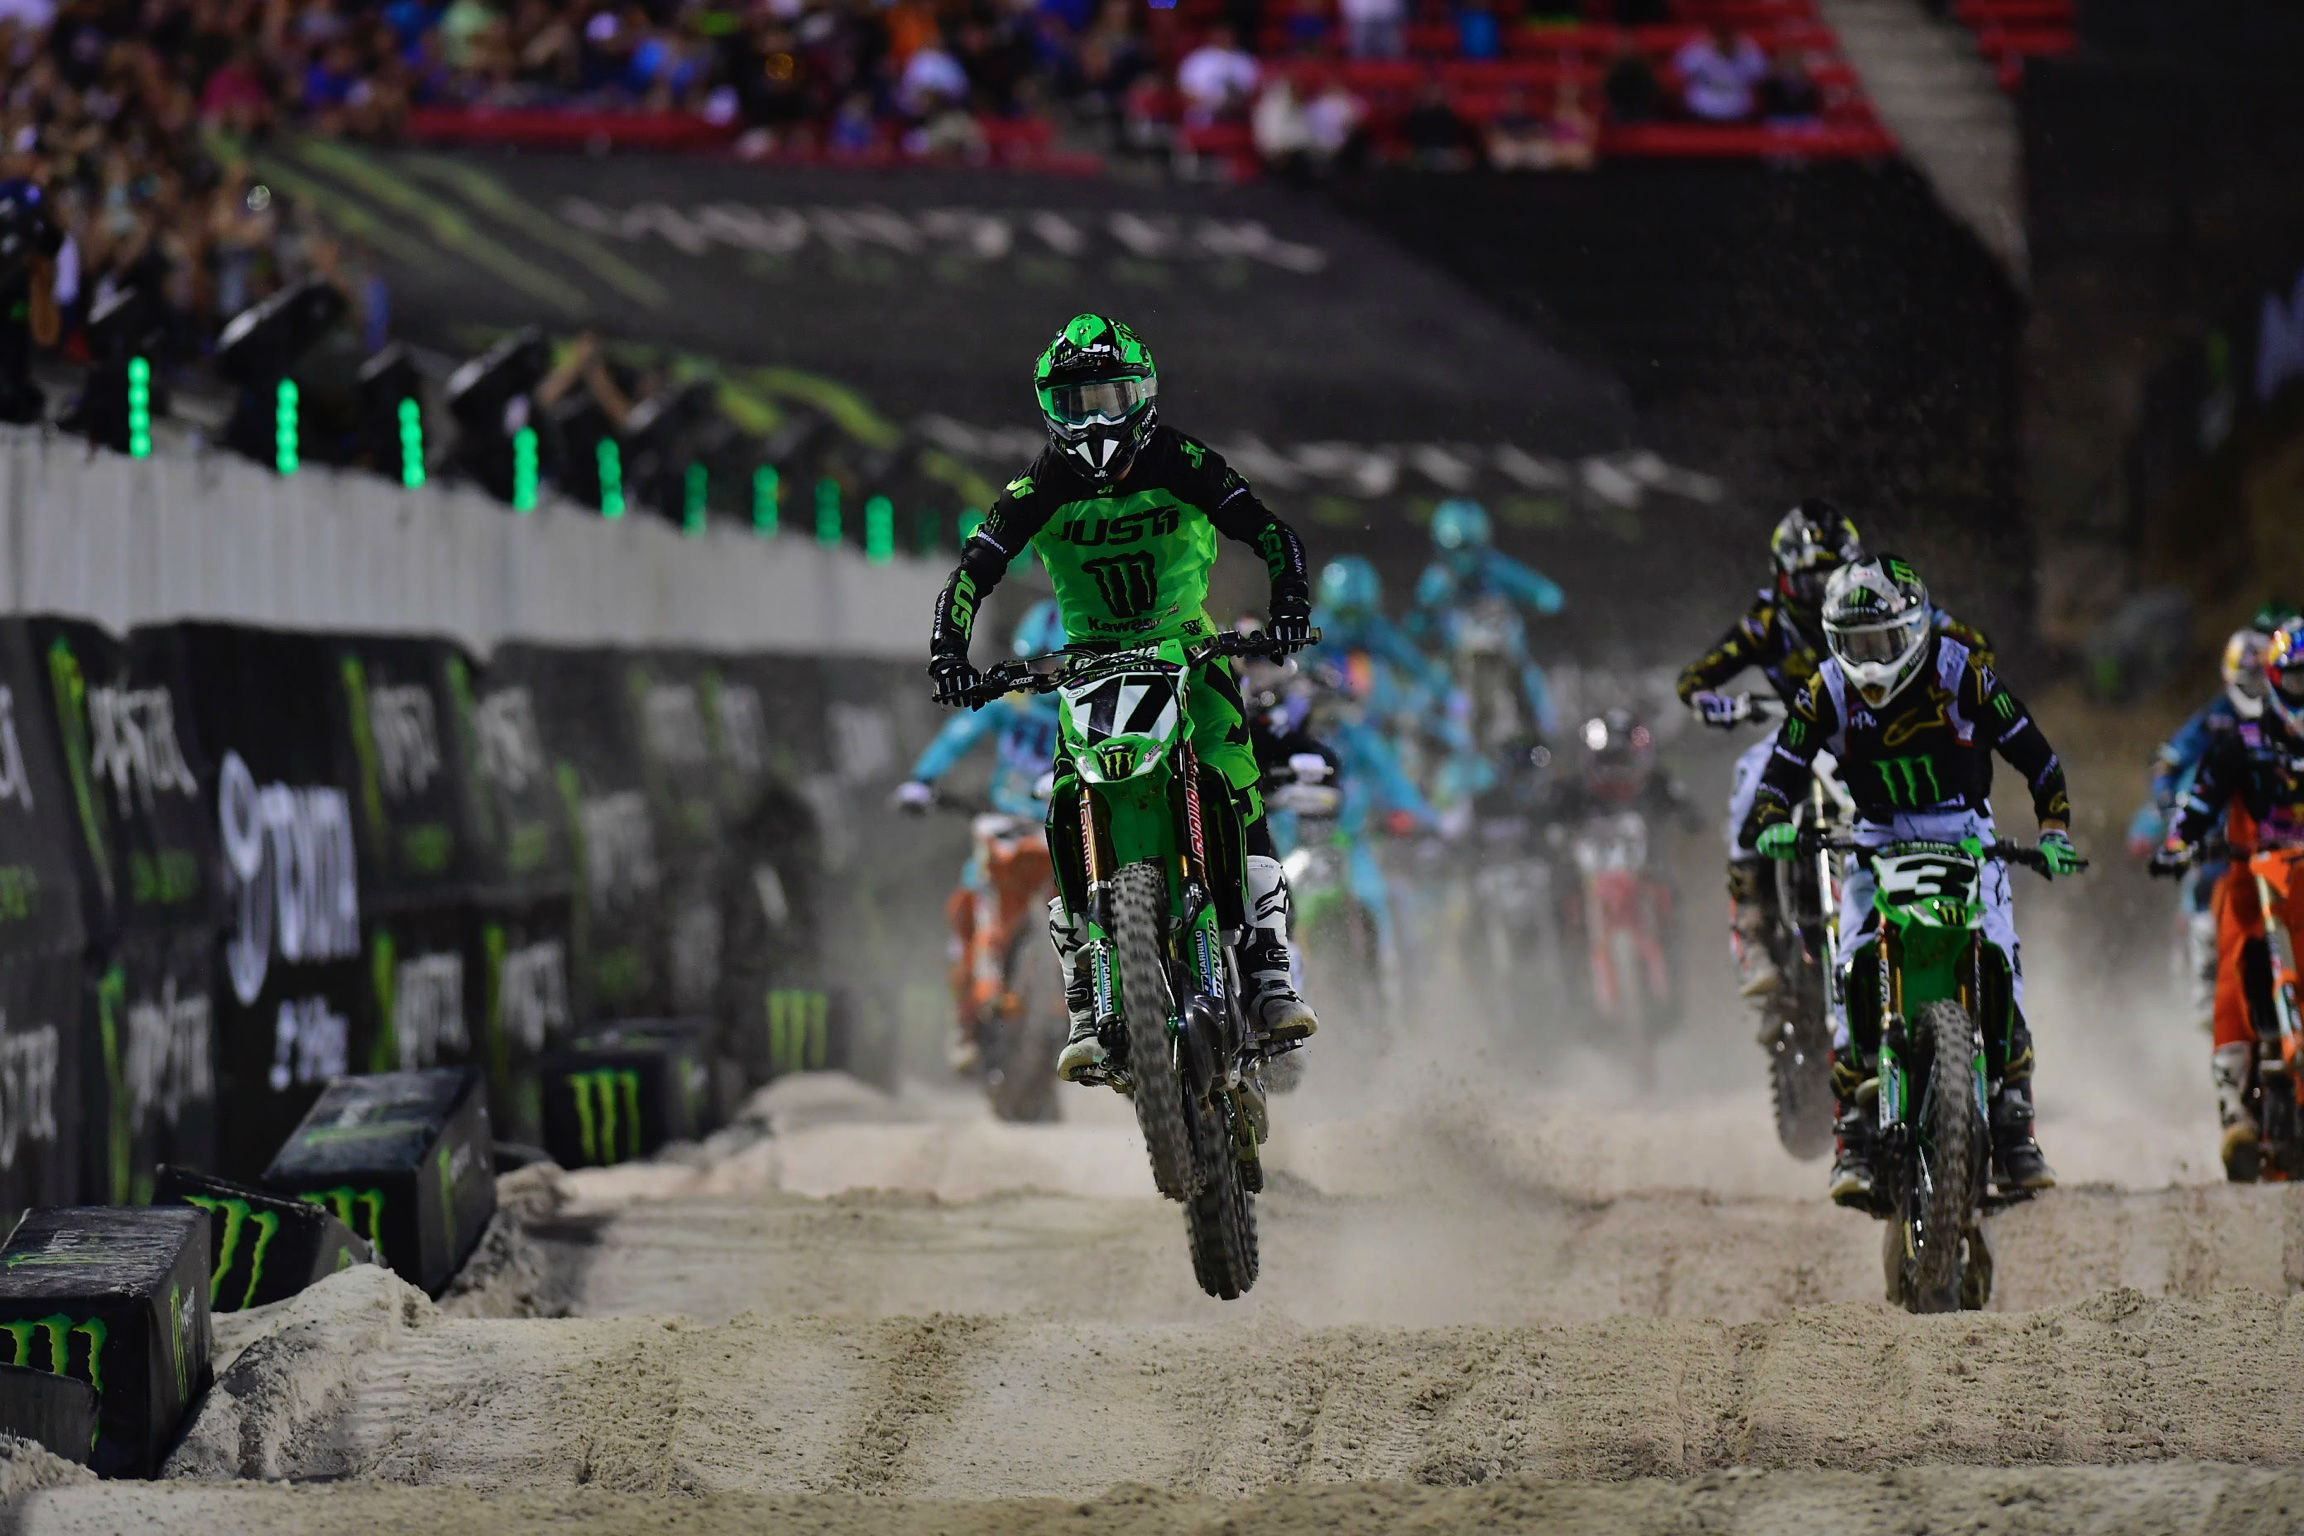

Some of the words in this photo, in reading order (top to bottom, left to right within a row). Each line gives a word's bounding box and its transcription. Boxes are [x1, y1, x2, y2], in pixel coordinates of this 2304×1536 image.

[1075, 674, 1180, 748] 17
[1887, 858, 1978, 906] 3
[1195, 930, 1208, 975] CARRILLO
[1207, 918, 1224, 998] DUNLOP
[1102, 966, 1113, 1012] CARRILLO
